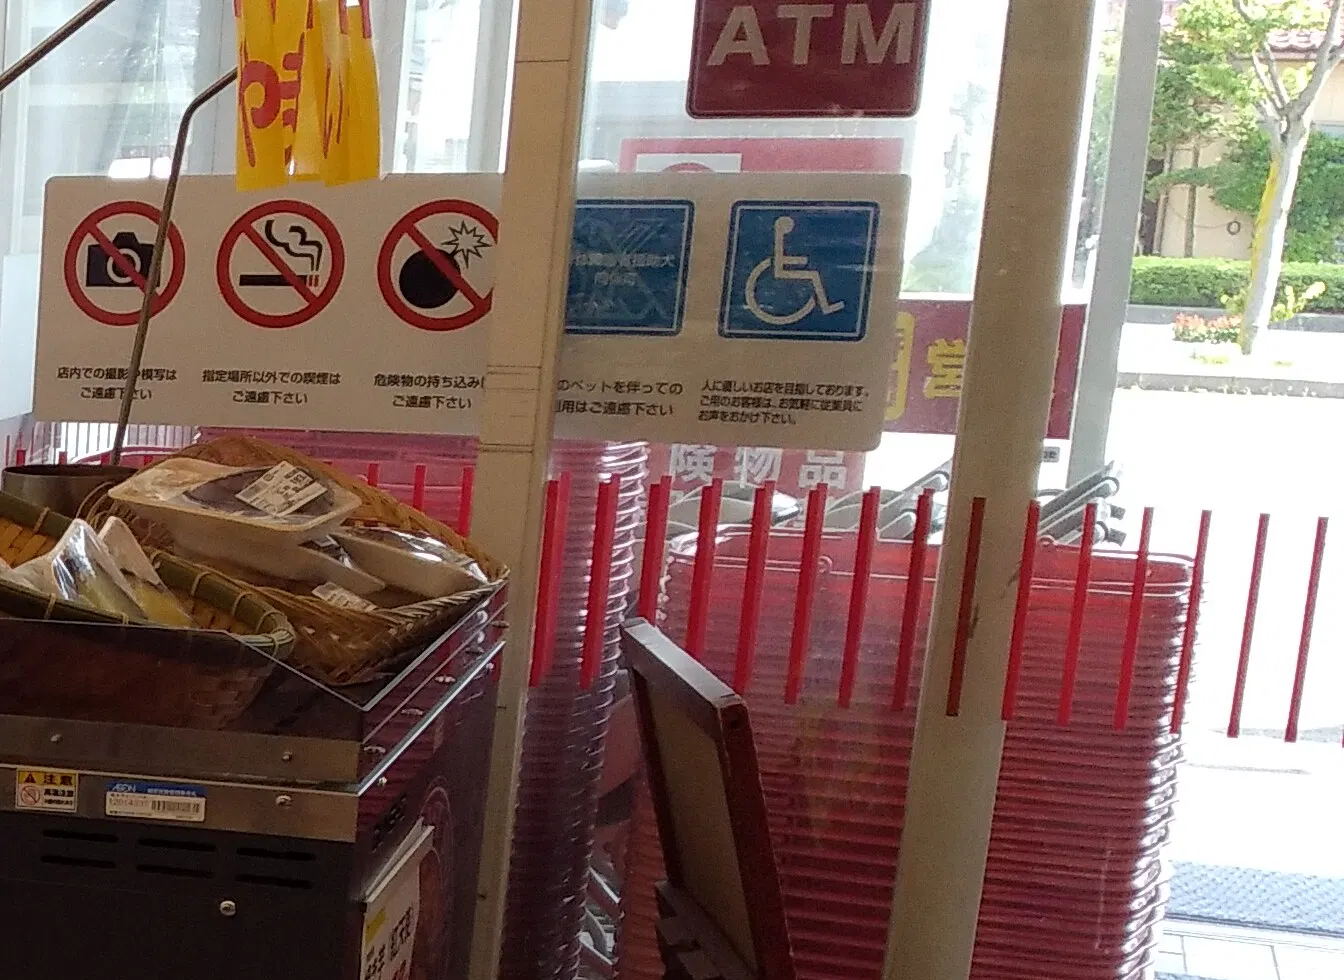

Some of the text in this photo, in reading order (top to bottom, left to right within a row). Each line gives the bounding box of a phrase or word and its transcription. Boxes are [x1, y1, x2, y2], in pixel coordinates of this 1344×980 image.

[707, 3, 911, 67] ATM
[202, 369, 341, 387] 指定場所以外での喫煙は
[80, 387, 152, 402] ご遠慮下さい
[557, 379, 683, 396] のペットを伴っての
[701, 379, 869, 398] 人に優しいお店を目指しております。
[232, 390, 308, 405] ご遠慮下さい
[392, 394, 472, 410] ご遠慮下さい
[698, 409, 797, 425] お声をおかけ下さい。
[43, 774, 72, 785] 注意
